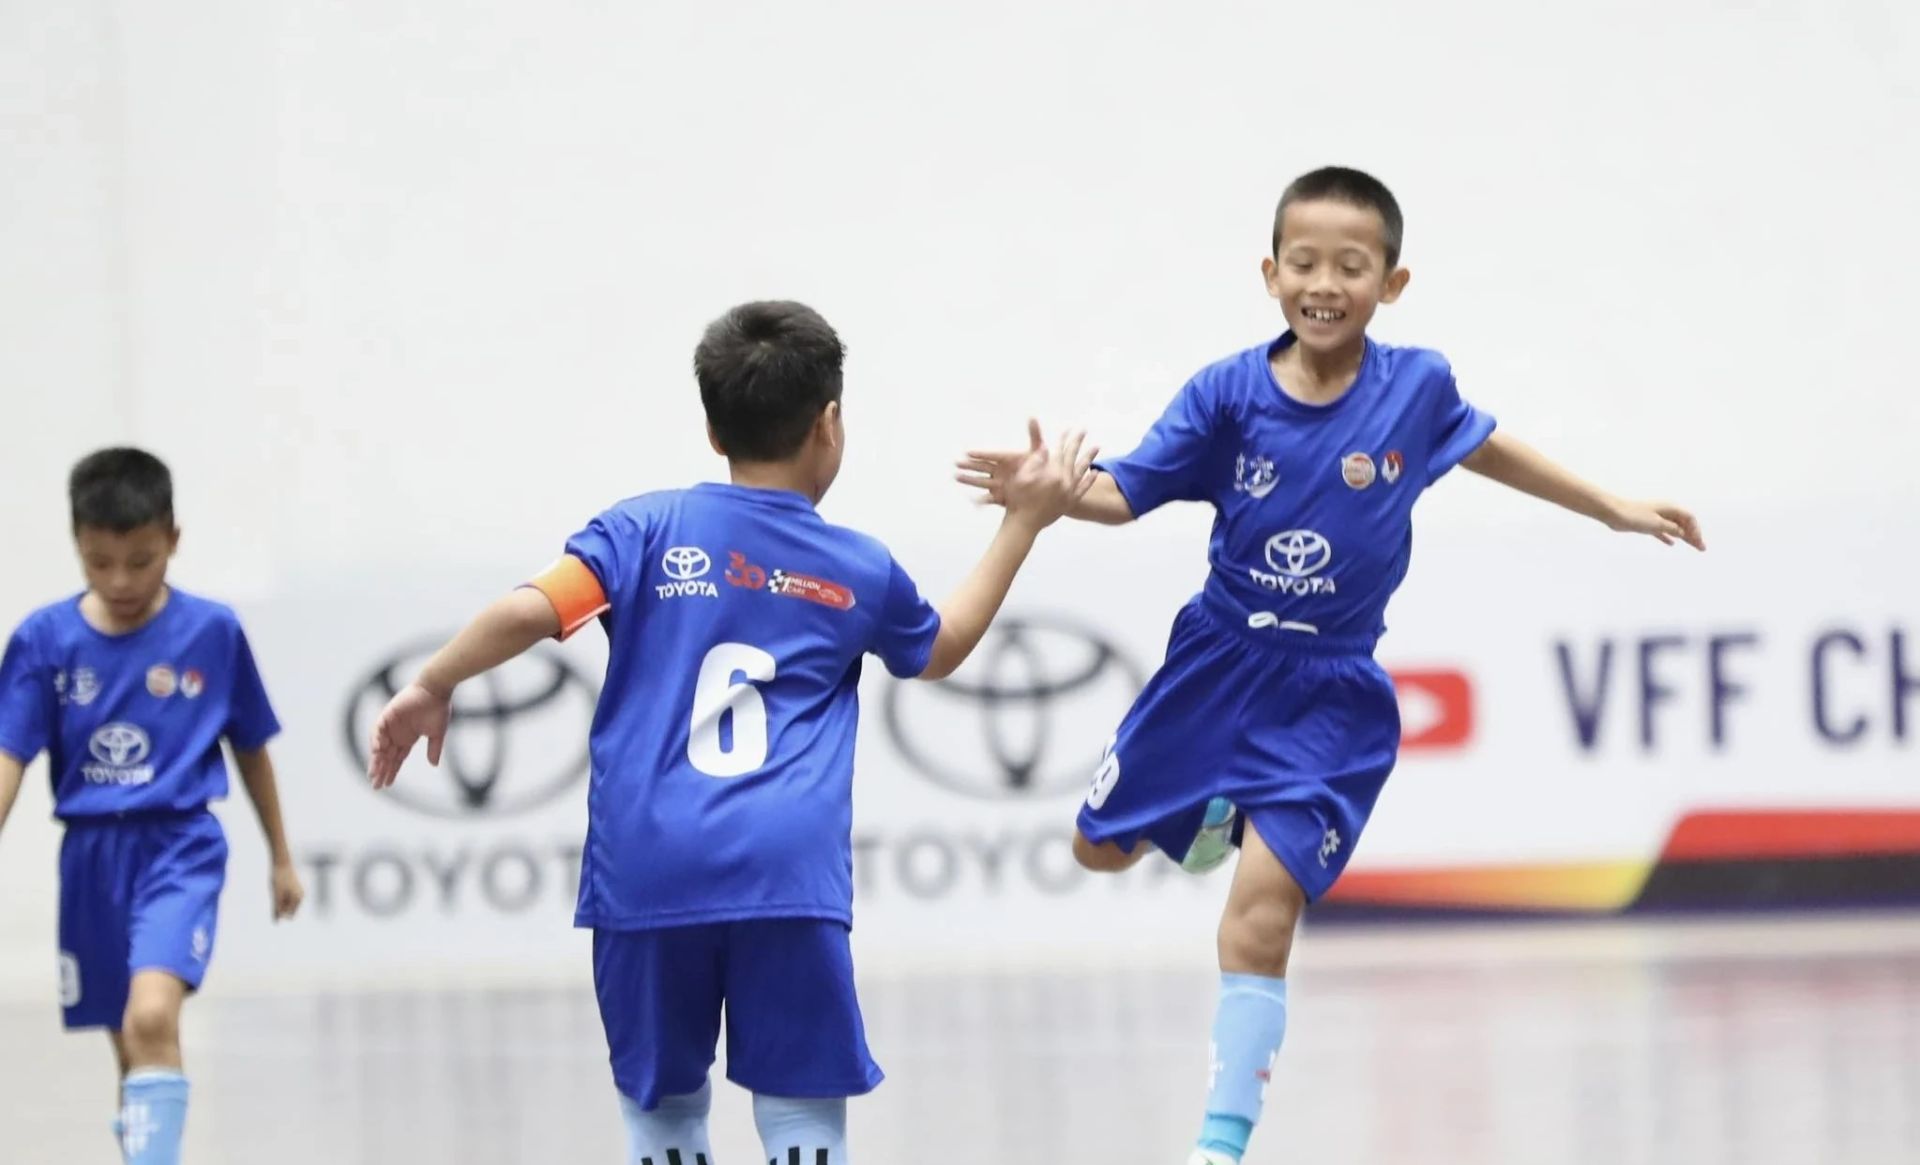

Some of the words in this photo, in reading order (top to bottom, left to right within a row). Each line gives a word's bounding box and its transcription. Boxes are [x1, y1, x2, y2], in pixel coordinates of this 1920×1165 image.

[655, 579, 719, 600] TOYOTA
[1249, 568, 1336, 596] TOYOTA
[687, 642, 776, 778] 6
[1553, 632, 1759, 753] VFF
[302, 840, 586, 921] TOYOT
